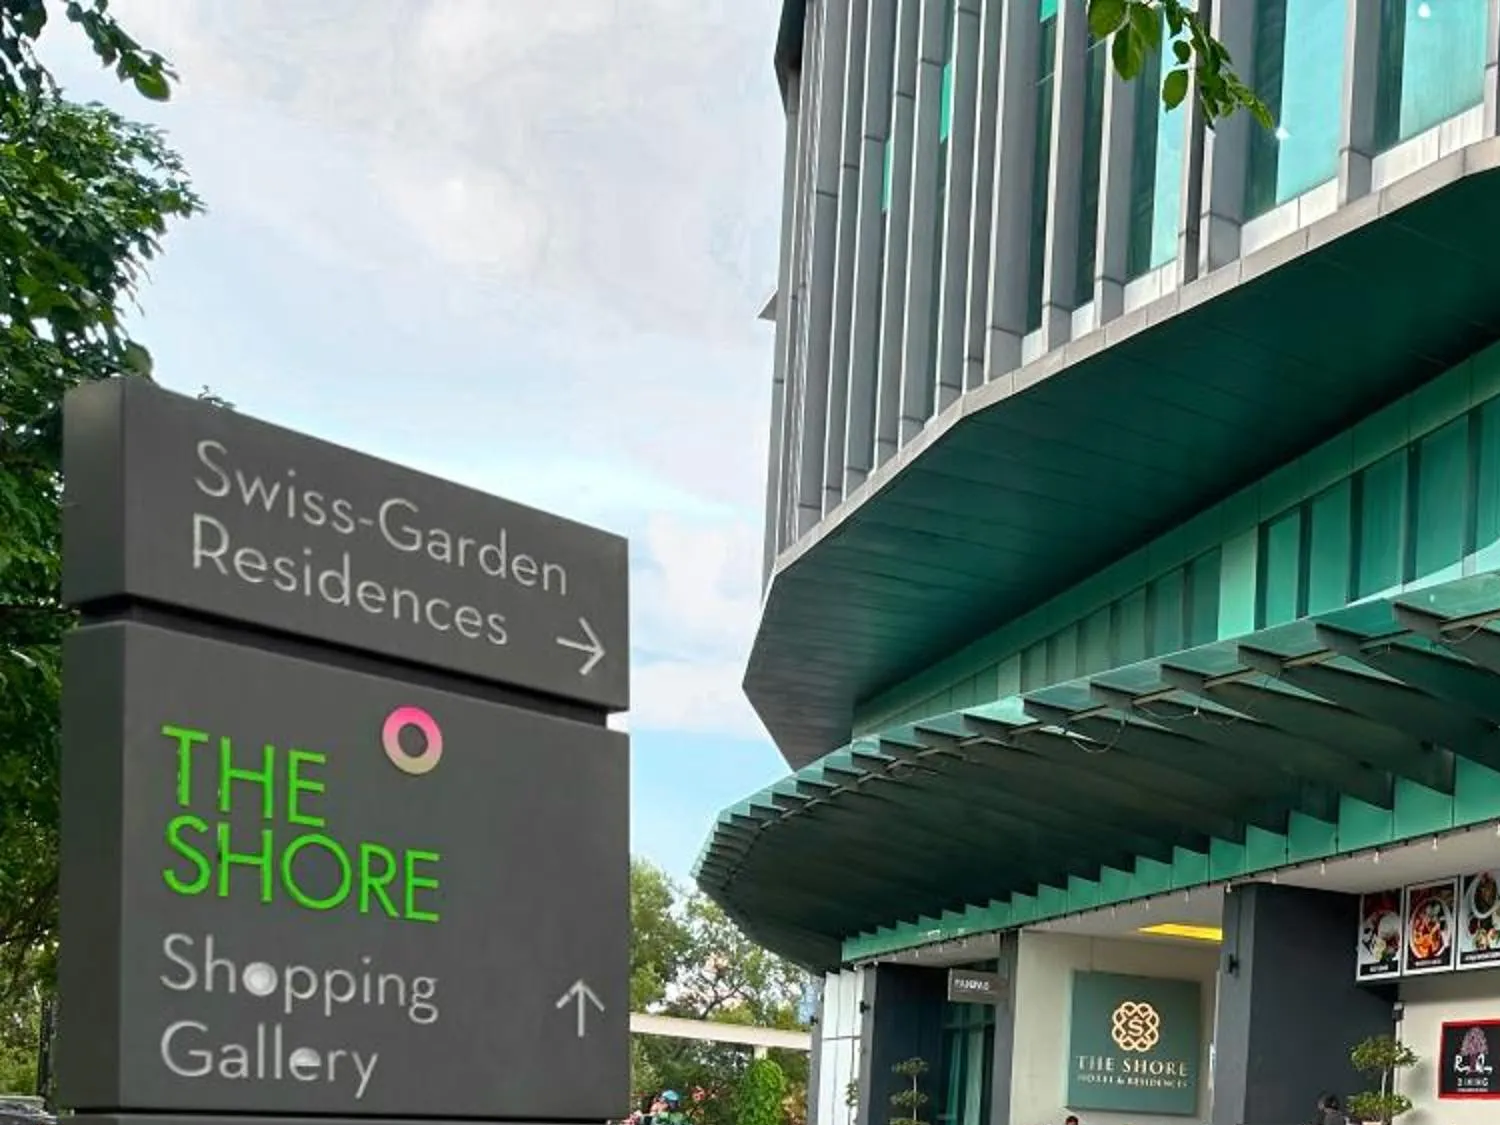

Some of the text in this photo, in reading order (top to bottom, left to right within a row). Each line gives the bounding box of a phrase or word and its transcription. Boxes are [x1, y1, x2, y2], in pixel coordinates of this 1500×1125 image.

[194, 438, 568, 597] Swiss-Garden
[191, 511, 509, 646] Residences
[162, 724, 326, 828] THE
[163, 813, 441, 923] SHORE
[159, 932, 440, 1024] Shopping
[159, 1019, 379, 1099] Gallery
[1077, 1055, 1189, 1077] THE SHORE
